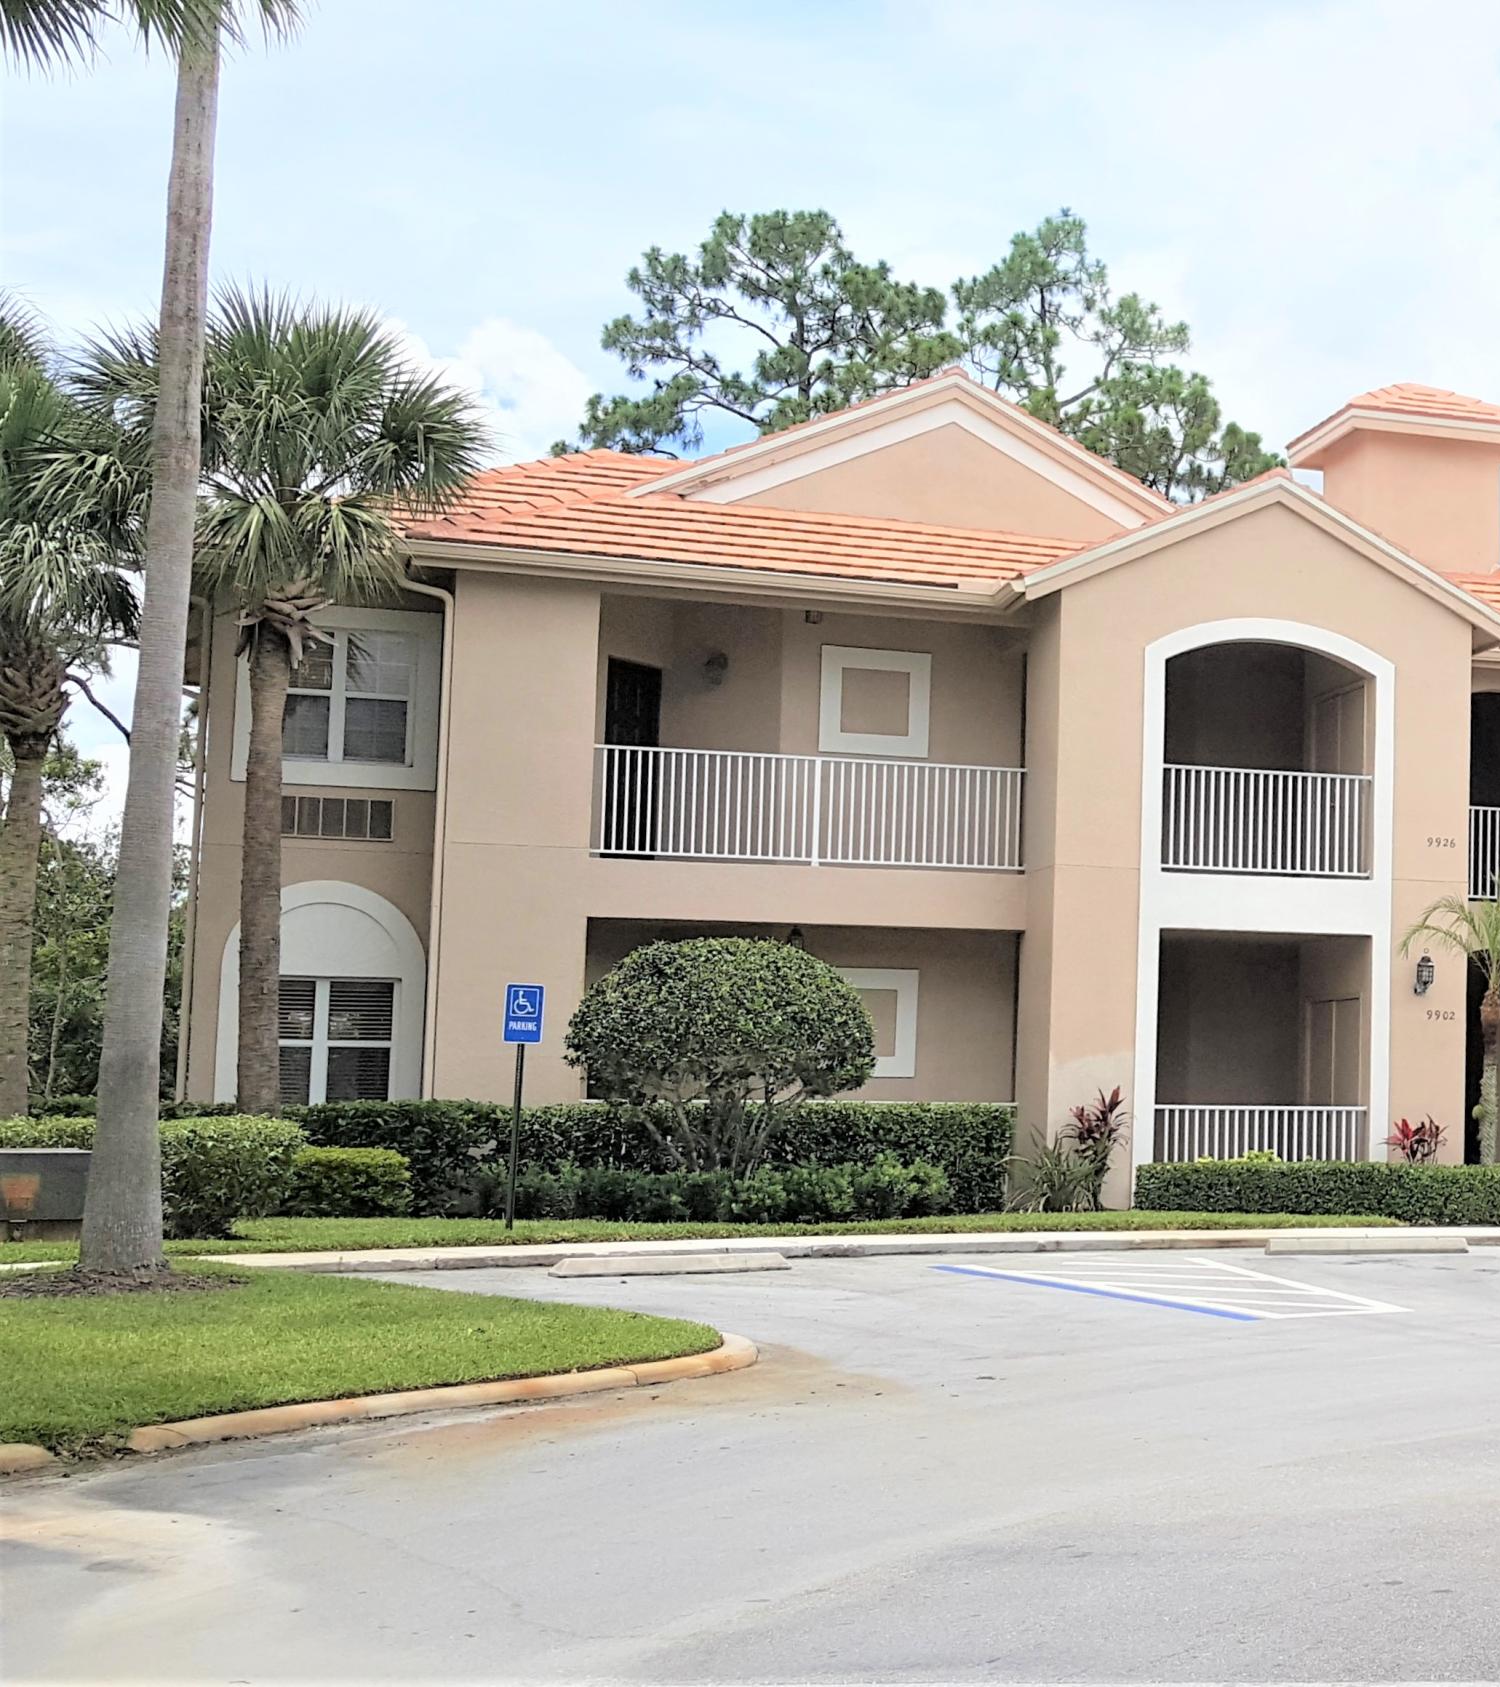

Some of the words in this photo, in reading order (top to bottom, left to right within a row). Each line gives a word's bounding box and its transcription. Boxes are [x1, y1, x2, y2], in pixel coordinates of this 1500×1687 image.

[1426, 836, 1456, 849] 9926
[1426, 1009, 1455, 1021] 9902
[508, 1021, 537, 1031] PARKING
